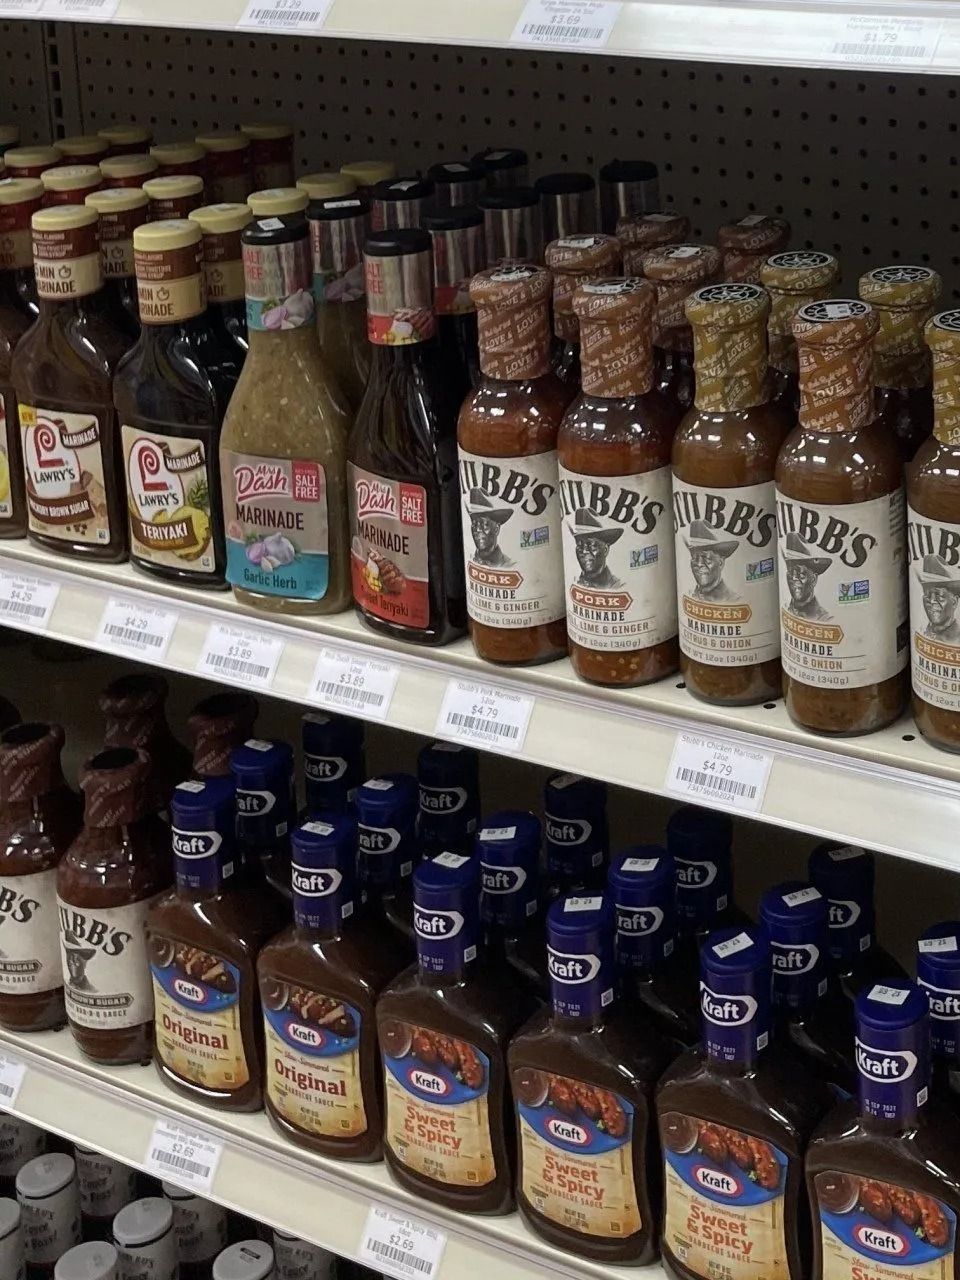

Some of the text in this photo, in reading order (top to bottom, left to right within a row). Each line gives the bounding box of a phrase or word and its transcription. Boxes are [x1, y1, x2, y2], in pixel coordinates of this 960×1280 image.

[551, 15, 581, 25] $3.69
[864, 32, 898, 43] $1.79
[40, 265, 55, 279] MIN
[34, 468, 75, 484] LAWRY'S
[235, 464, 288, 494] Dash
[295, 476, 318, 488] SALT
[294, 486, 319, 500] FREE
[458, 459, 555, 517] TUBB'S
[138, 489, 181, 508] LAWRY'S
[401, 496, 423, 511] SALT
[560, 478, 664, 535] TUBB'S
[235, 503, 304, 531] MARINADE
[401, 510, 424, 524] FREE
[141, 520, 188, 541] TERIYAKI
[357, 520, 410, 556] MARINADE
[243, 568, 297, 590] Garlic Herb
[471, 569, 512, 585] PORK
[10, 589, 32, 602] $4.29
[470, 581, 516, 600] MARINADE
[575, 591, 620, 608] PORK
[380, 594, 410, 617] Teriyaki
[503, 600, 541, 612] GINGER
[573, 604, 625, 622] MARINADE
[685, 603, 742, 620] CHICKEN
[124, 616, 148, 630] $4.29
[580, 621, 650, 634] LIME GINGER
[687, 619, 742, 637] MARINADE
[719, 638, 752, 649] ONION
[228, 646, 252, 660] $3.89
[811, 658, 843, 670] ONION
[339, 674, 365, 687] $3.89
[470, 704, 499, 719] $4.79
[681, 734, 705, 748] Stubb's
[706, 739, 732, 754] Chicken
[713, 751, 729, 762] 12oz
[702, 760, 733, 776] $4.79
[177, 981, 200, 1000] Kraft
[162, 1015, 230, 1051] Original
[292, 1025, 316, 1043] Kraft
[859, 1050, 899, 1077] Kraft
[274, 1059, 347, 1097] Original
[415, 1074, 441, 1092] Kraft
[407, 1105, 457, 1134] Sweet
[416, 1124, 462, 1151] Spicy
[553, 1123, 582, 1142] Kraft
[172, 1143, 195, 1158] $2.69
[545, 1156, 598, 1183] Sweet
[555, 1175, 604, 1202] Spicy
[702, 1169, 731, 1192] Kraft
[690, 1206, 748, 1237] Sweet
[389, 1235, 415, 1251] $2.69
[703, 1223, 754, 1255] Spicy
[864, 1231, 897, 1251] Kraft
